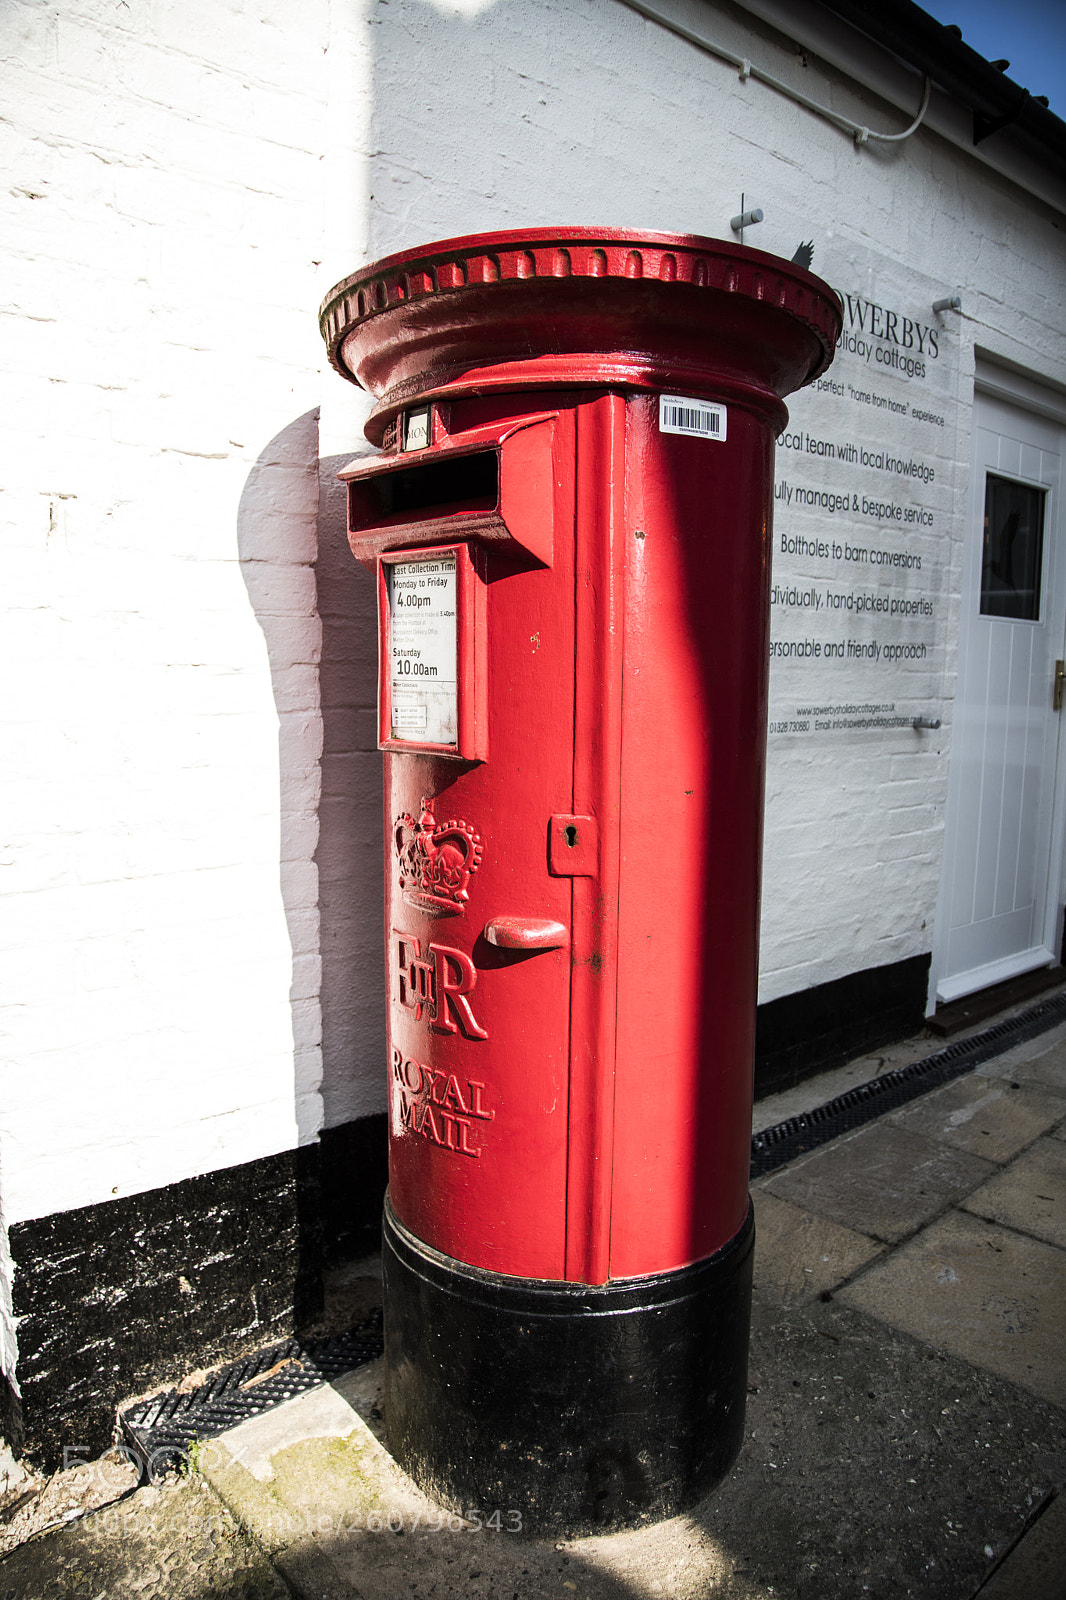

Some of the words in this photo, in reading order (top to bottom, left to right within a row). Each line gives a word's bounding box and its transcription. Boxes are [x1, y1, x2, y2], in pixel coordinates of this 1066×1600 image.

[875, 346, 926, 379] cottages
[817, 378, 845, 397] perfect
[872, 392, 888, 409] from
[912, 408, 945, 427] experience
[775, 431, 804, 451] ocal
[806, 433, 835, 458] team
[837, 443, 858, 464] with
[860, 446, 884, 469] local
[886, 451, 935, 484] knowledge
[796, 489, 850, 513] managed
[852, 494, 860, 512] &
[862, 496, 902, 521] bespoke
[904, 508, 934, 527] service
[781, 533, 829, 559] Boltholes
[832, 541, 843, 560] to
[844, 542, 868, 564] barn
[870, 550, 922, 570] conversions
[393, 565, 406, 575] Last
[408, 563, 439, 574] Collection
[393, 579, 417, 590] Monday
[419, 579, 425, 587] to
[427, 577, 448, 588] Friday
[397, 591, 431, 609] 4.00pm
[827, 589, 889, 614] hand-picked
[891, 597, 933, 617] properties
[393, 647, 421, 658] Saturday
[824, 640, 845, 658] and
[847, 640, 881, 662] friendly
[883, 642, 927, 662] approach
[397, 659, 438, 676] 10.00am
[392, 1045, 496, 1120] ROYAL
[400, 1090, 482, 1159] MAIL
